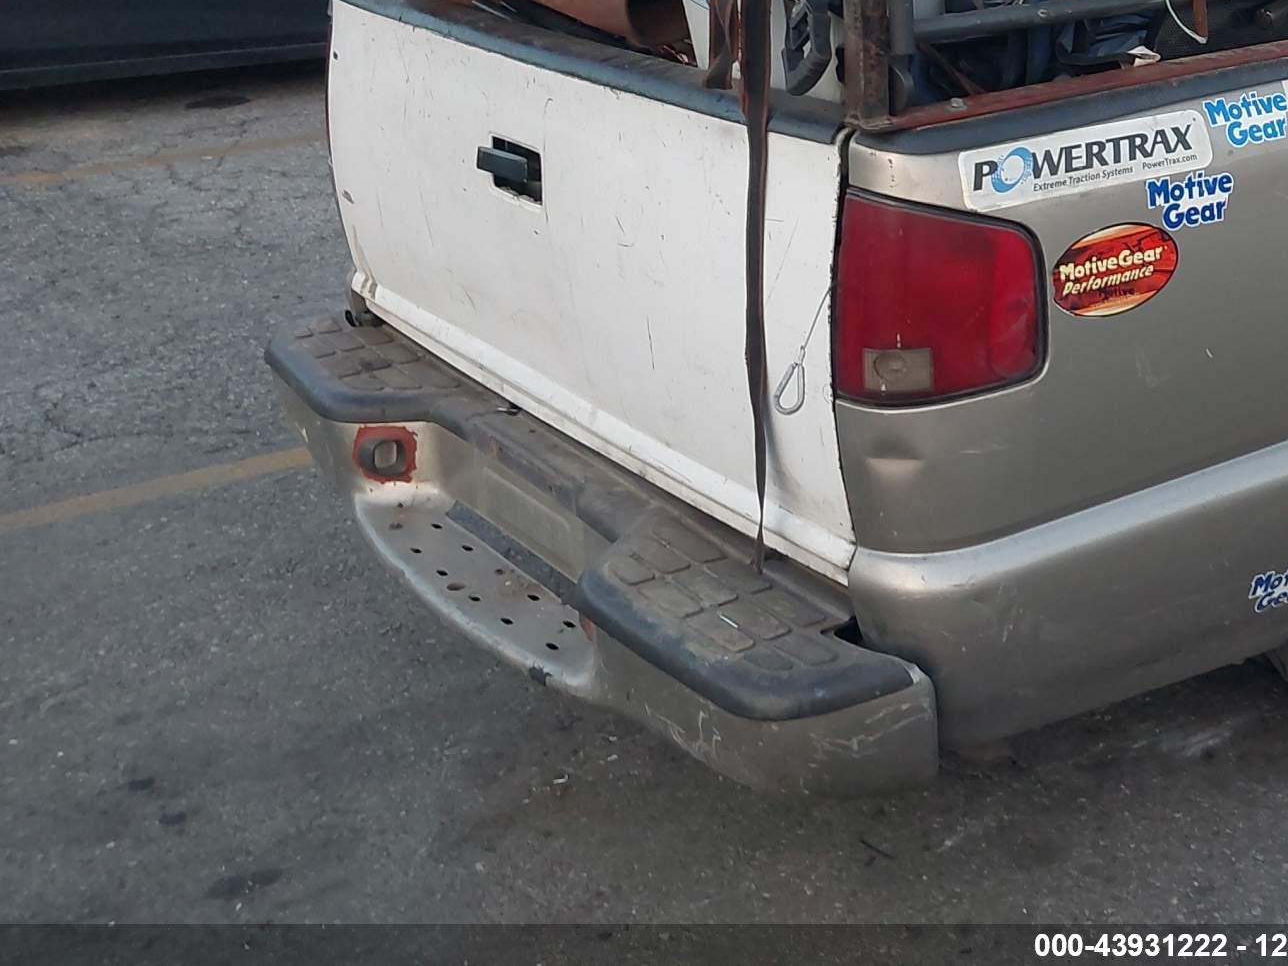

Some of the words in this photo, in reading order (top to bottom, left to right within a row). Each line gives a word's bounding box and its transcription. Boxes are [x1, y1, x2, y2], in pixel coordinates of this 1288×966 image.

[1206, 92, 1287, 125] Motive
[1229, 115, 1286, 146] Gear
[973, 123, 1193, 193] POWERTRAX
[1033, 180, 1067, 192] Extreme
[1069, 172, 1100, 185] Traction
[1102, 165, 1133, 179] Systems
[1142, 153, 1198, 171] PowerTrax.com
[1148, 173, 1231, 207] Motive
[1163, 199, 1226, 229] Gear
[1062, 265, 1154, 296] Performance
